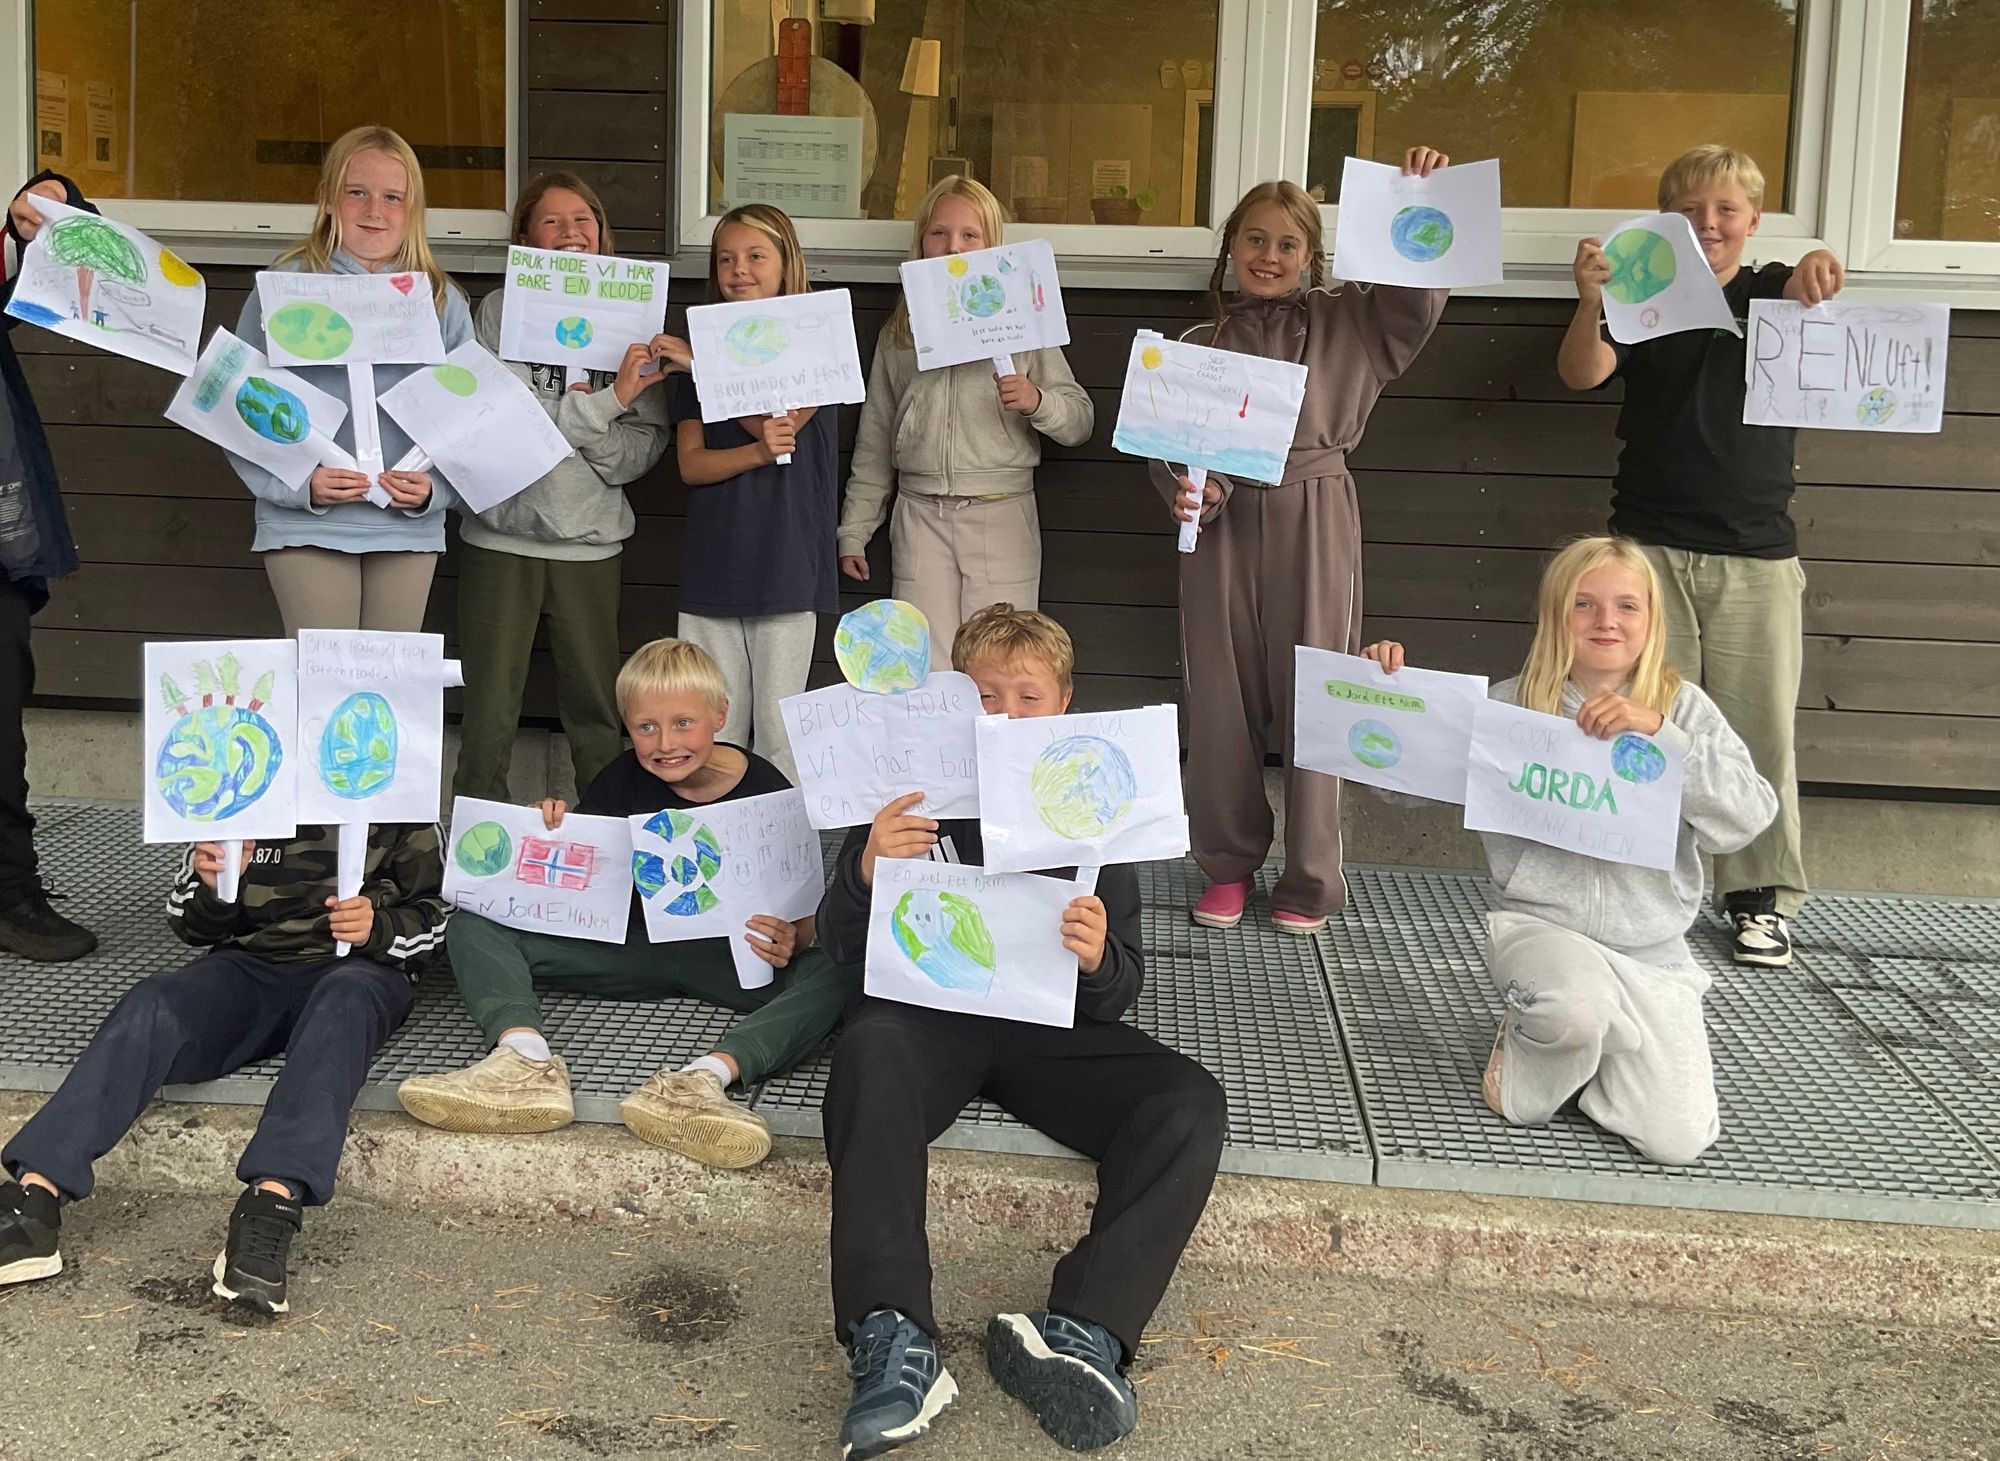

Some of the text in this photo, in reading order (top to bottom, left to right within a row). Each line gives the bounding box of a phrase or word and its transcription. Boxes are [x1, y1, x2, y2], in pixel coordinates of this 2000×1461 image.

[511, 251, 655, 282] BRUK HODE VI HAR
[517, 273, 653, 301] BARE EN KLODE
[1507, 761, 1619, 815] JORDA
